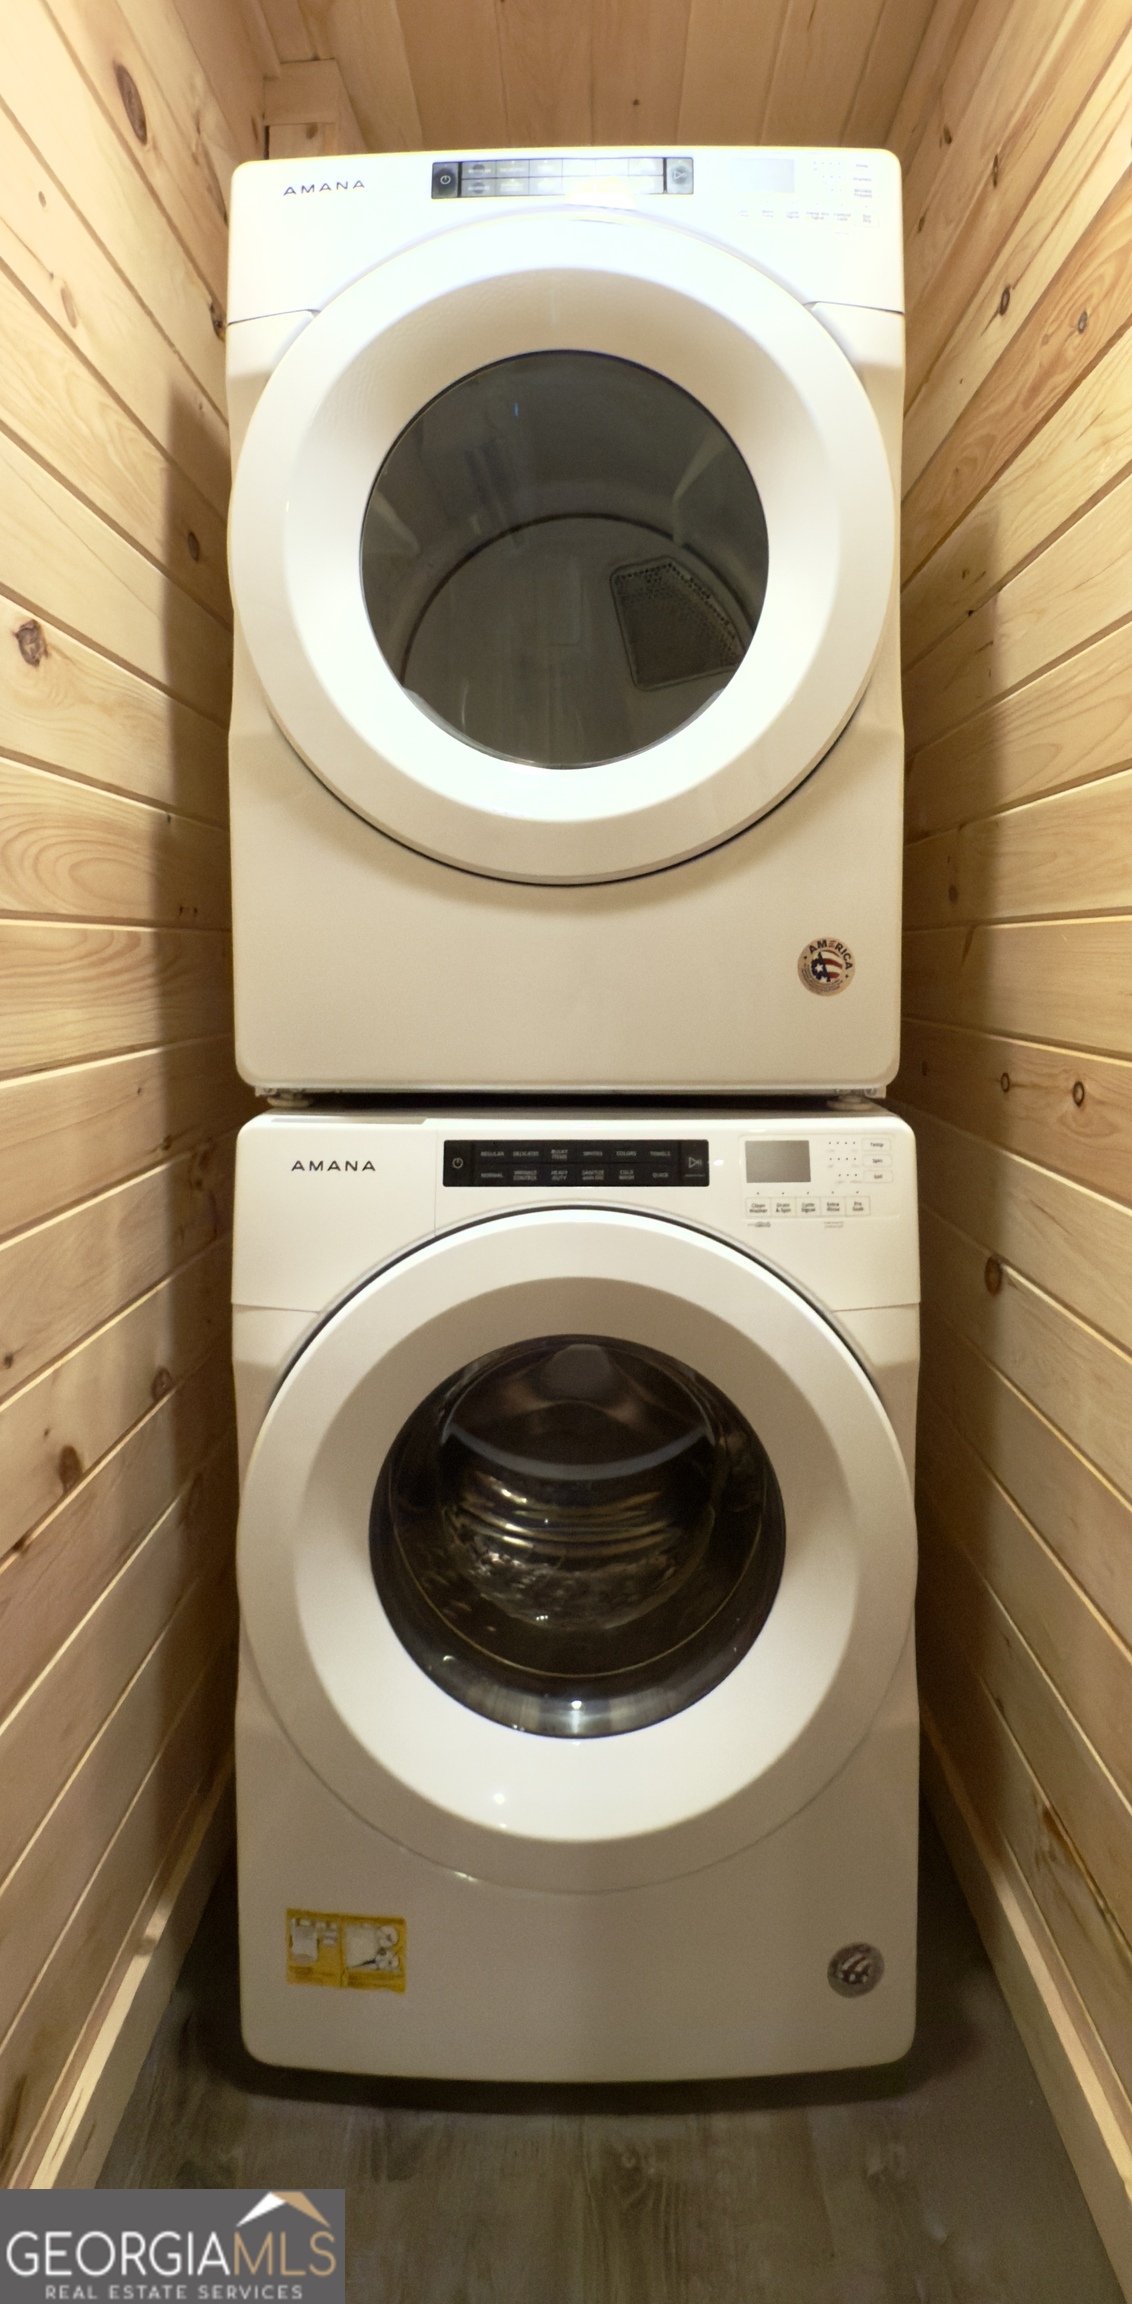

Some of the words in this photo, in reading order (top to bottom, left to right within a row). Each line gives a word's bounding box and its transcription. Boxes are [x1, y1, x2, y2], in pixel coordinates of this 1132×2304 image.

[283, 179, 366, 196] AMANA
[808, 939, 854, 970] AMERICA
[291, 1159, 377, 1172] AMANA
